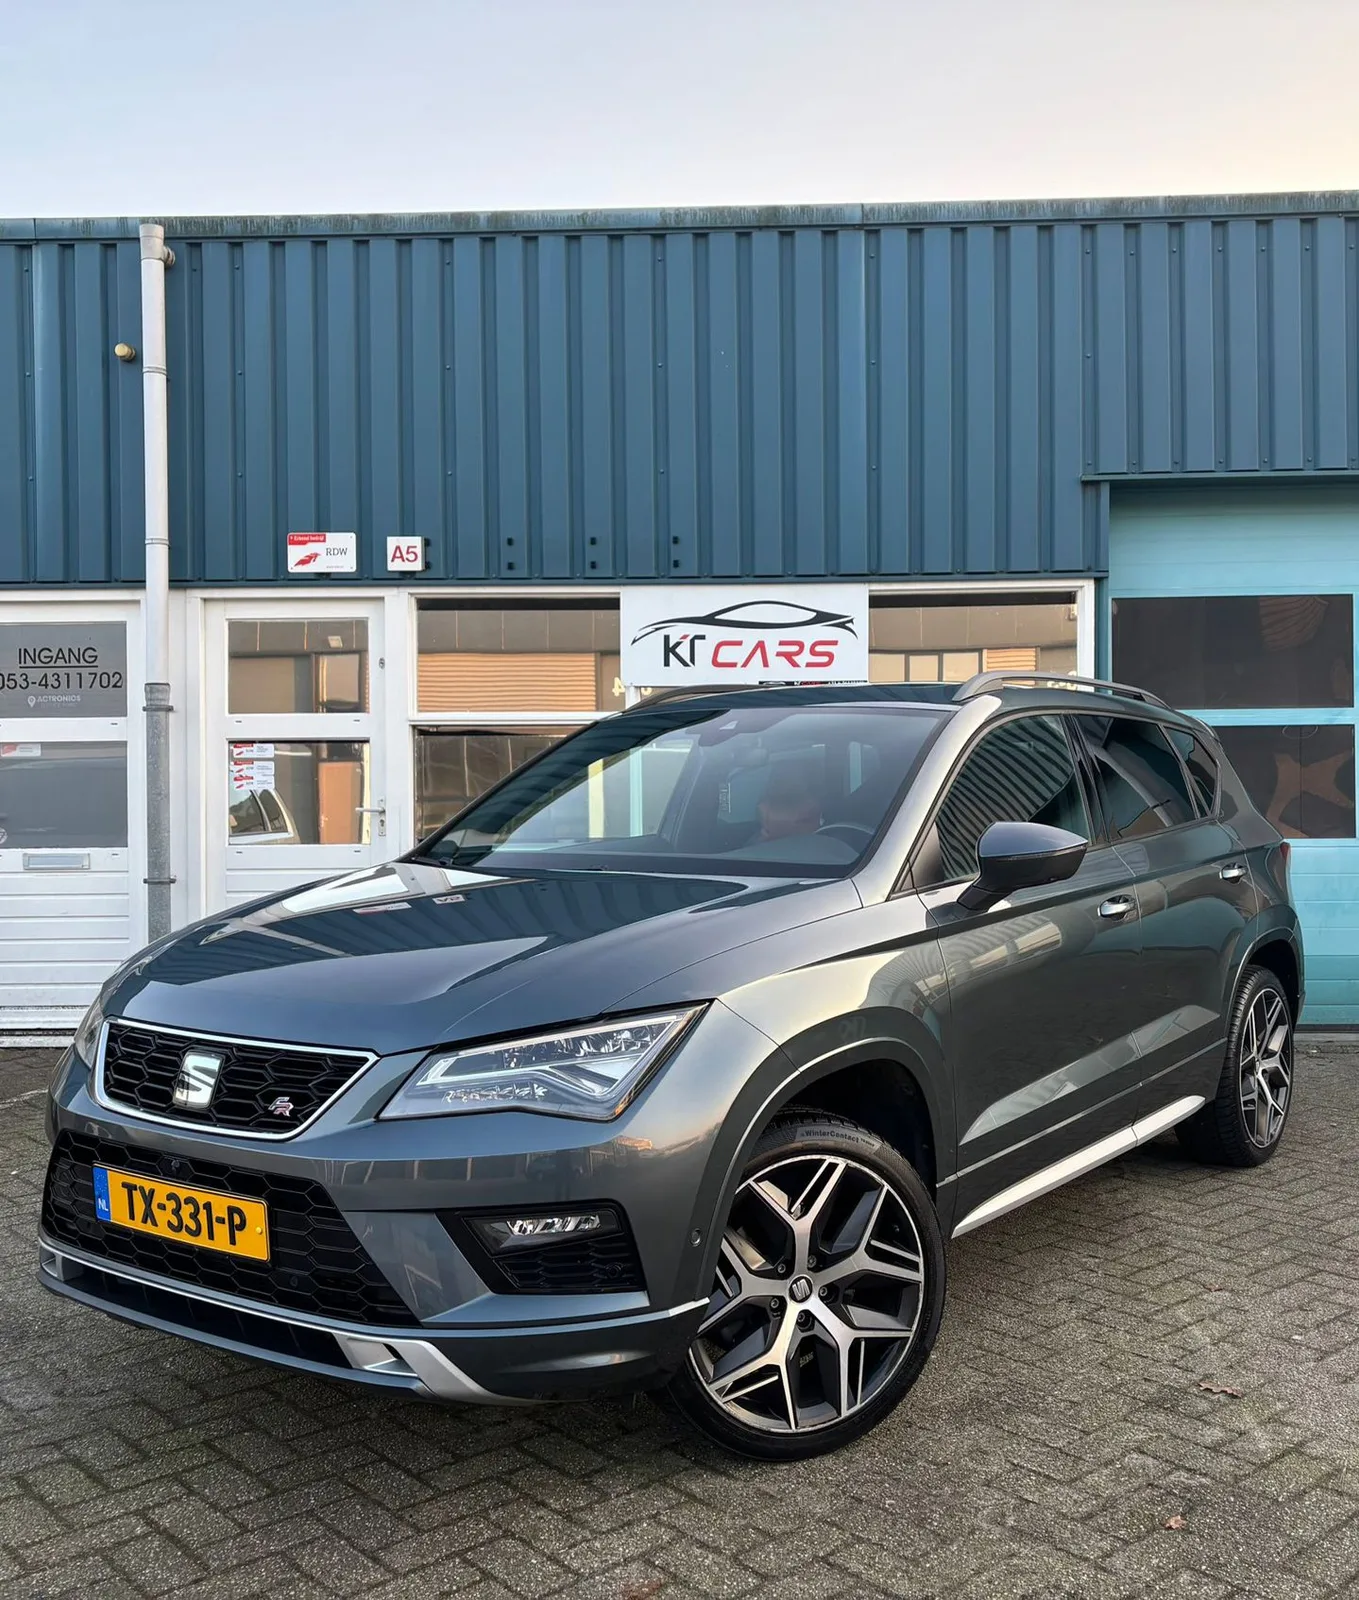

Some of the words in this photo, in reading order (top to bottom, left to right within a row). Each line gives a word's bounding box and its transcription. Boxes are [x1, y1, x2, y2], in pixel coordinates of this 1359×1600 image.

[325, 547, 348, 556] RDW
[390, 544, 419, 563] A5
[18, 647, 98, 665] INGANG
[711, 640, 839, 668] CARS
[37, 695, 81, 703] ACTRONICS
[805, 1130, 859, 1143] WinterContact
[98, 1198, 109, 1212] NL
[121, 1182, 247, 1246] TX-331-P
